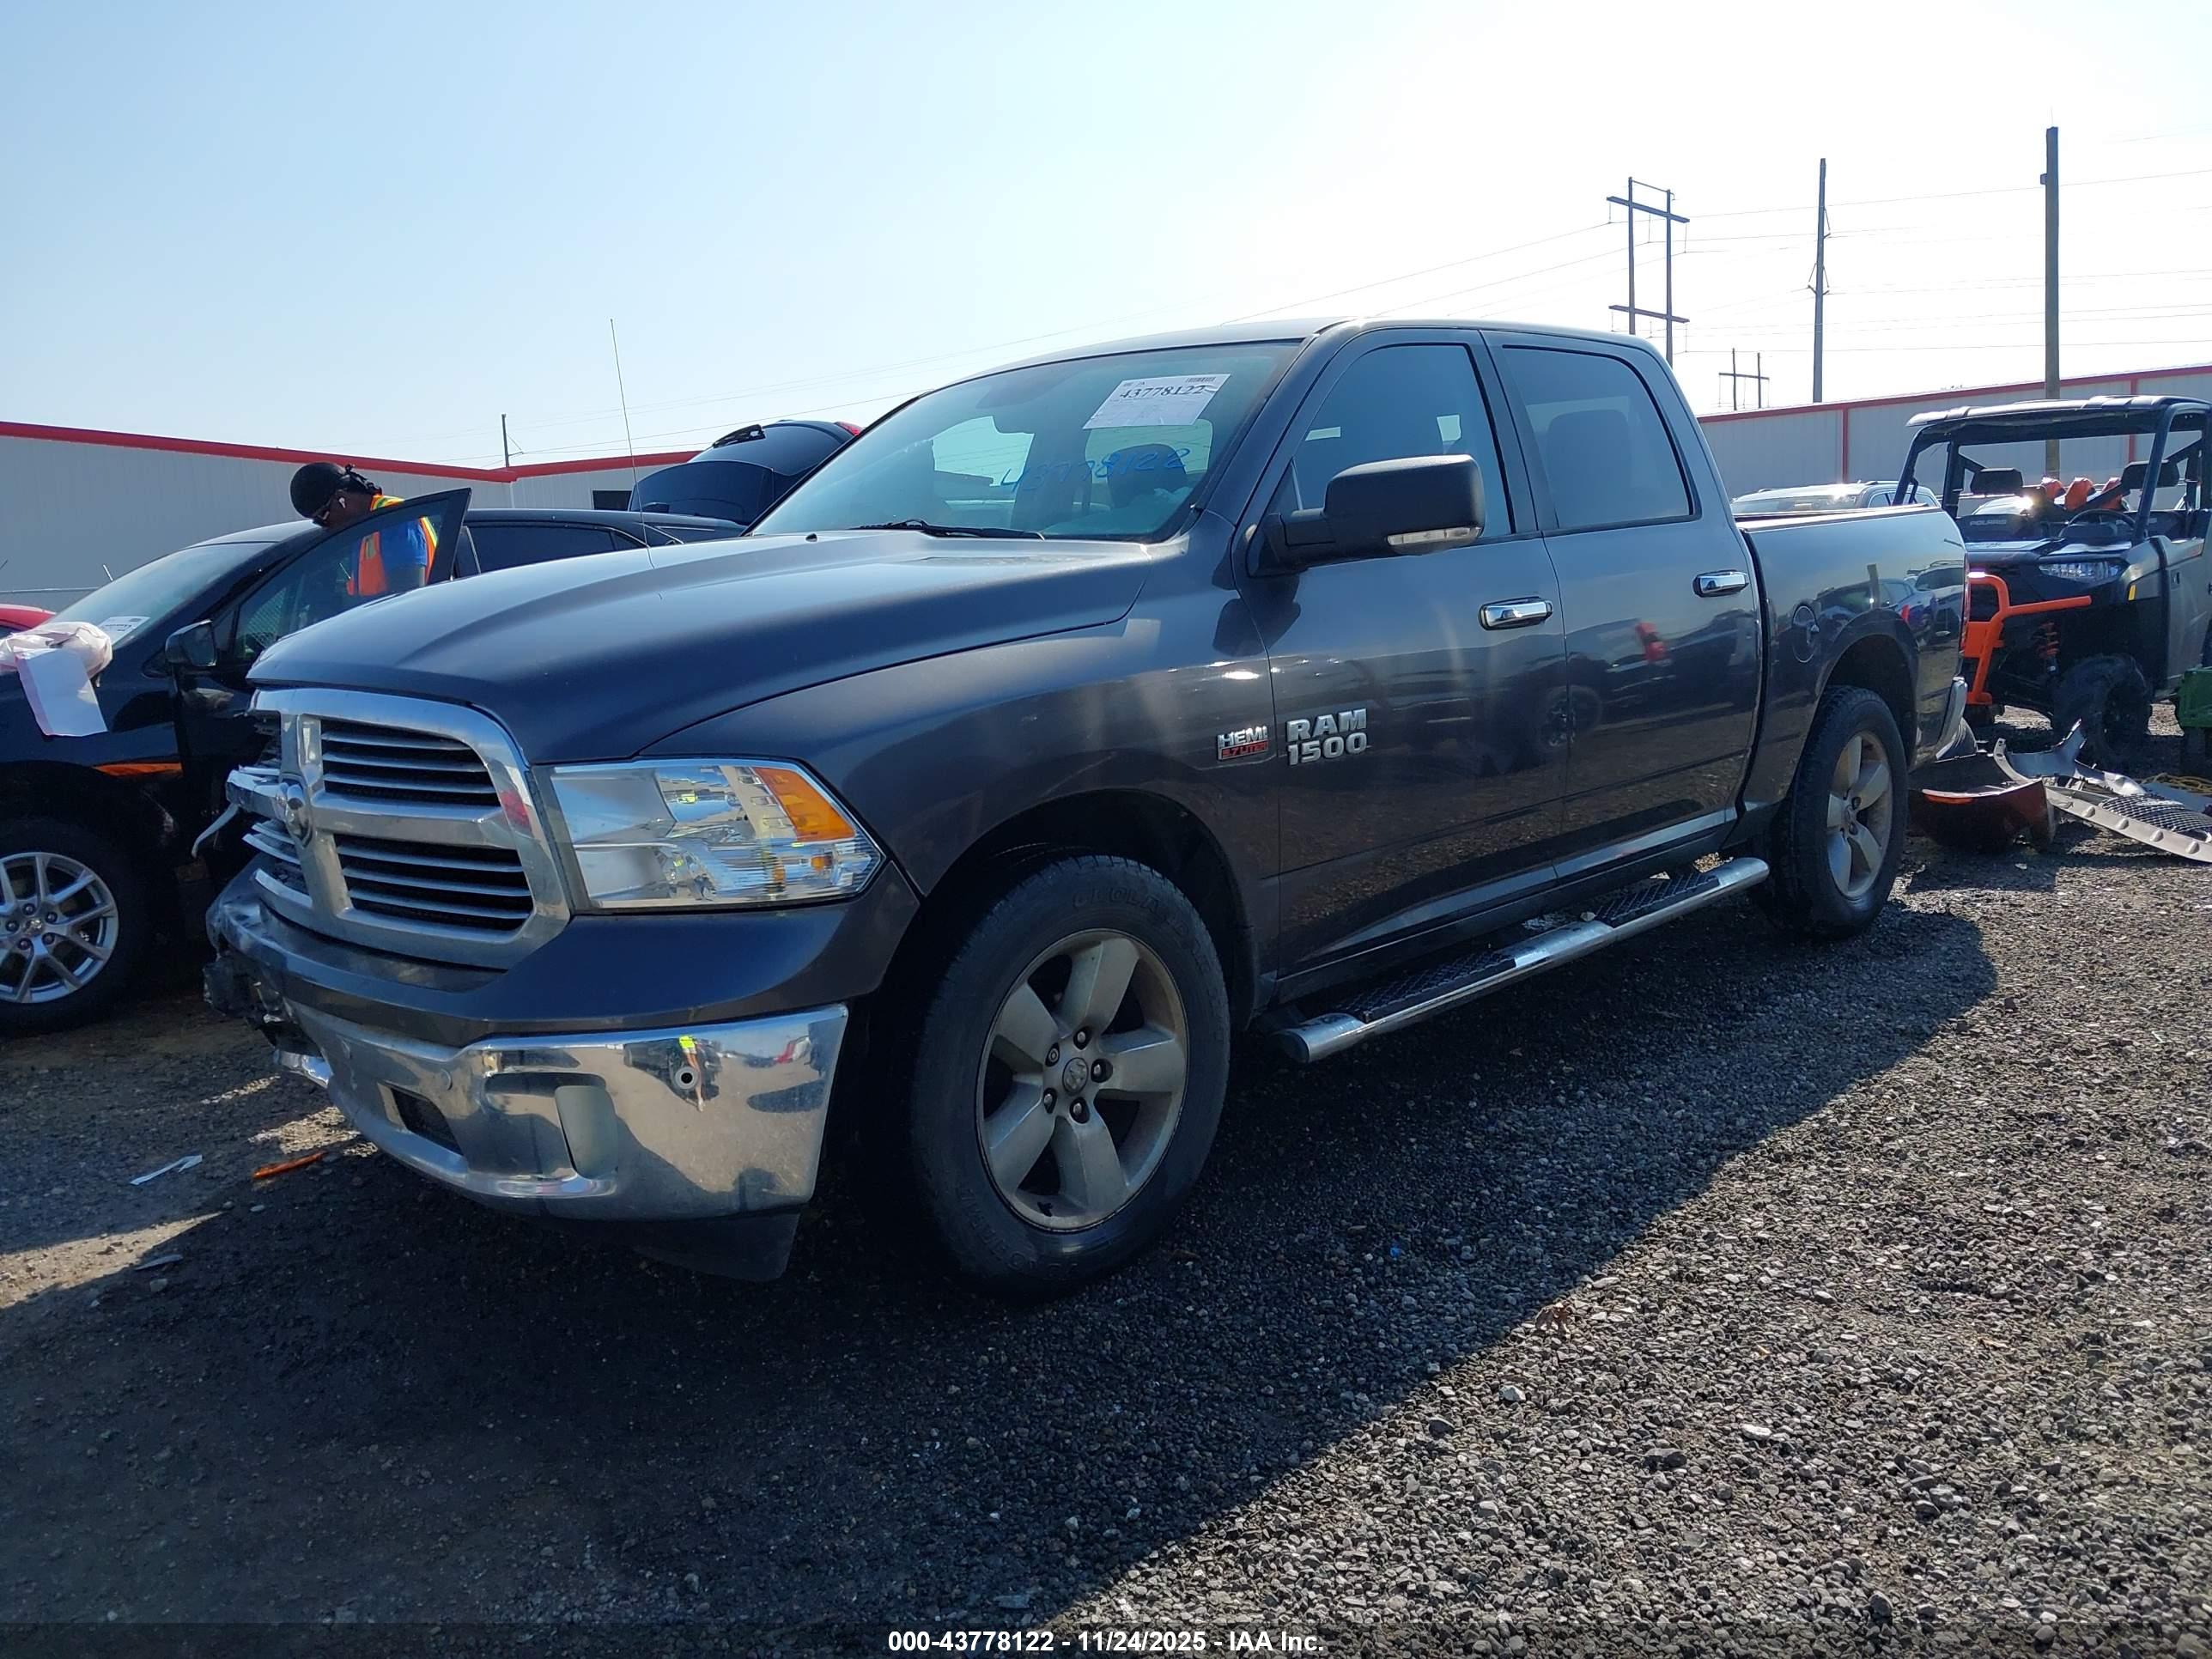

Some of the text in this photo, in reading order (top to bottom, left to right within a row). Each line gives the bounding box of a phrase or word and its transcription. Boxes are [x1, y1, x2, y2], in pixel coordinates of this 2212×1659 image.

[1119, 385, 1206, 398] 43778122
[1286, 708, 1367, 742] RAM
[1218, 726, 1267, 748] HEMI
[1239, 741, 1268, 755] LITER
[1288, 732, 1368, 766] 1500
